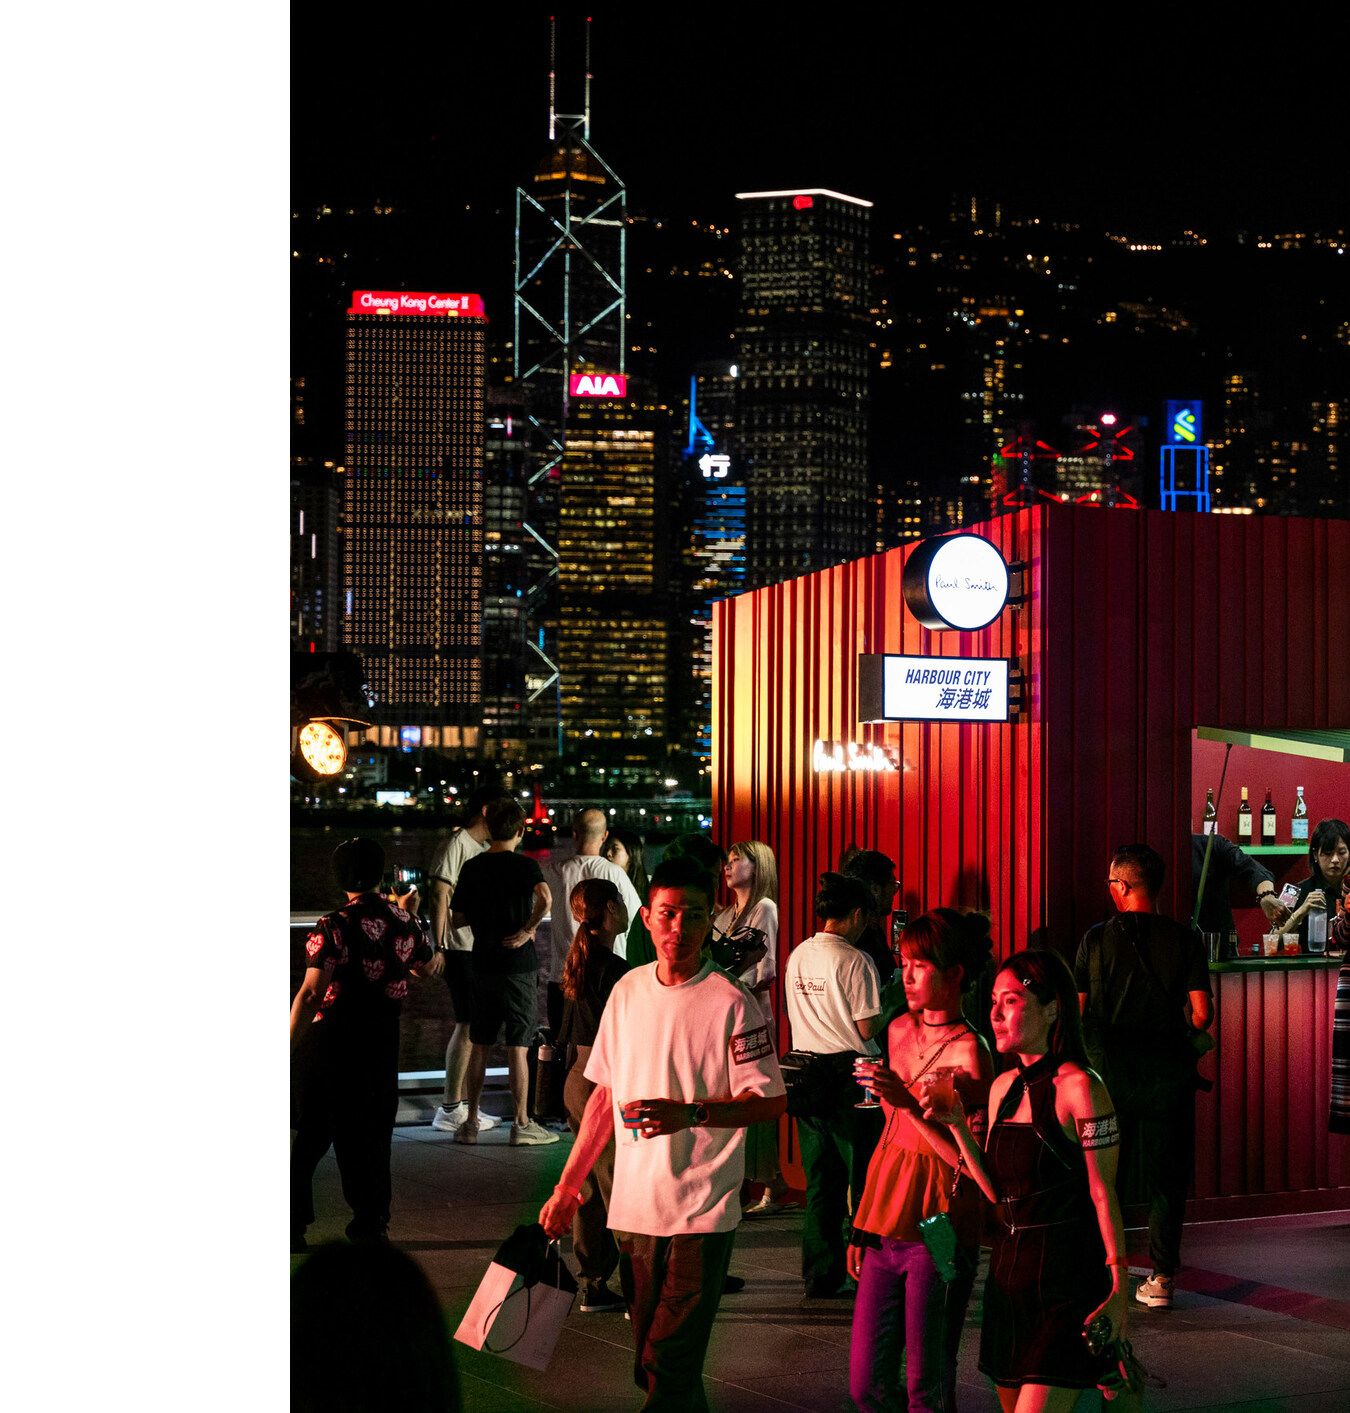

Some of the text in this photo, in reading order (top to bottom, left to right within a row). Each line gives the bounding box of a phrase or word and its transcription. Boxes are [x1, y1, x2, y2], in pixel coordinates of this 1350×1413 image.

[361, 292, 399, 311] Cheung
[400, 295, 427, 311] Kong
[428, 295, 460, 309] Center
[576, 376, 620, 395] AIA
[698, 453, 731, 478] 行
[935, 574, 998, 592] Paul Smith
[905, 669, 991, 686] HARBOUR CITY
[935, 687, 992, 710] 海港城
[807, 980, 827, 992] Paul
